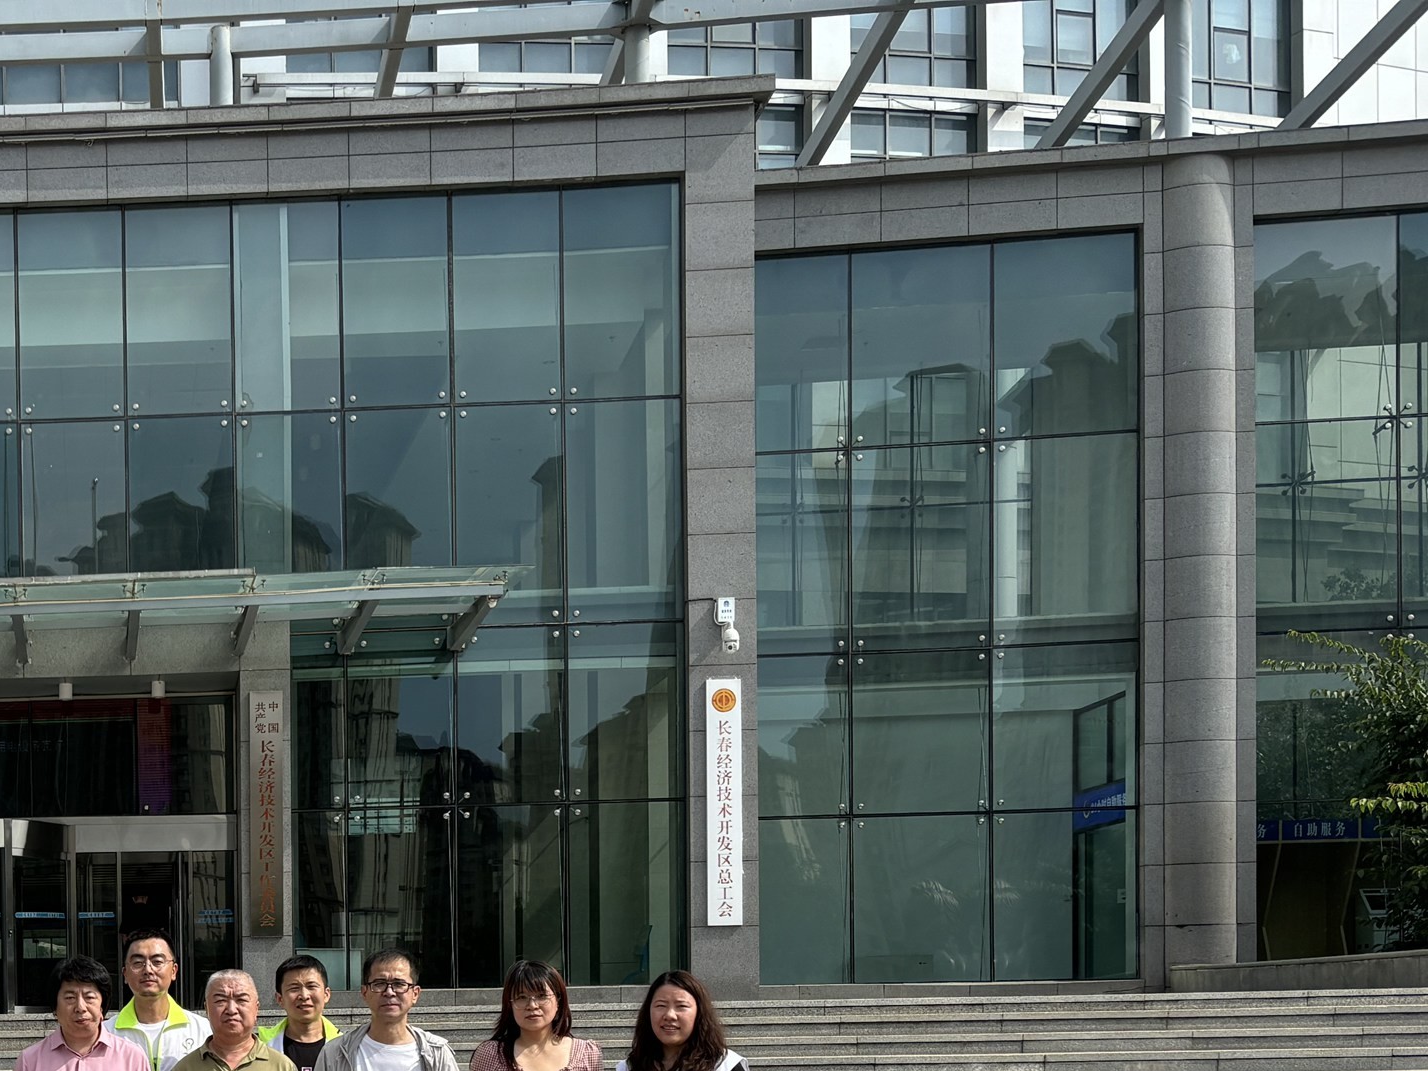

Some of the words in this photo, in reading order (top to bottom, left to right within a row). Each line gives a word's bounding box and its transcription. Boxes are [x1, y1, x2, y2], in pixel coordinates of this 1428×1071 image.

[716, 720, 733, 918] 长春经济技术开发区总工会
[1294, 822, 1346, 837] 自助服务
